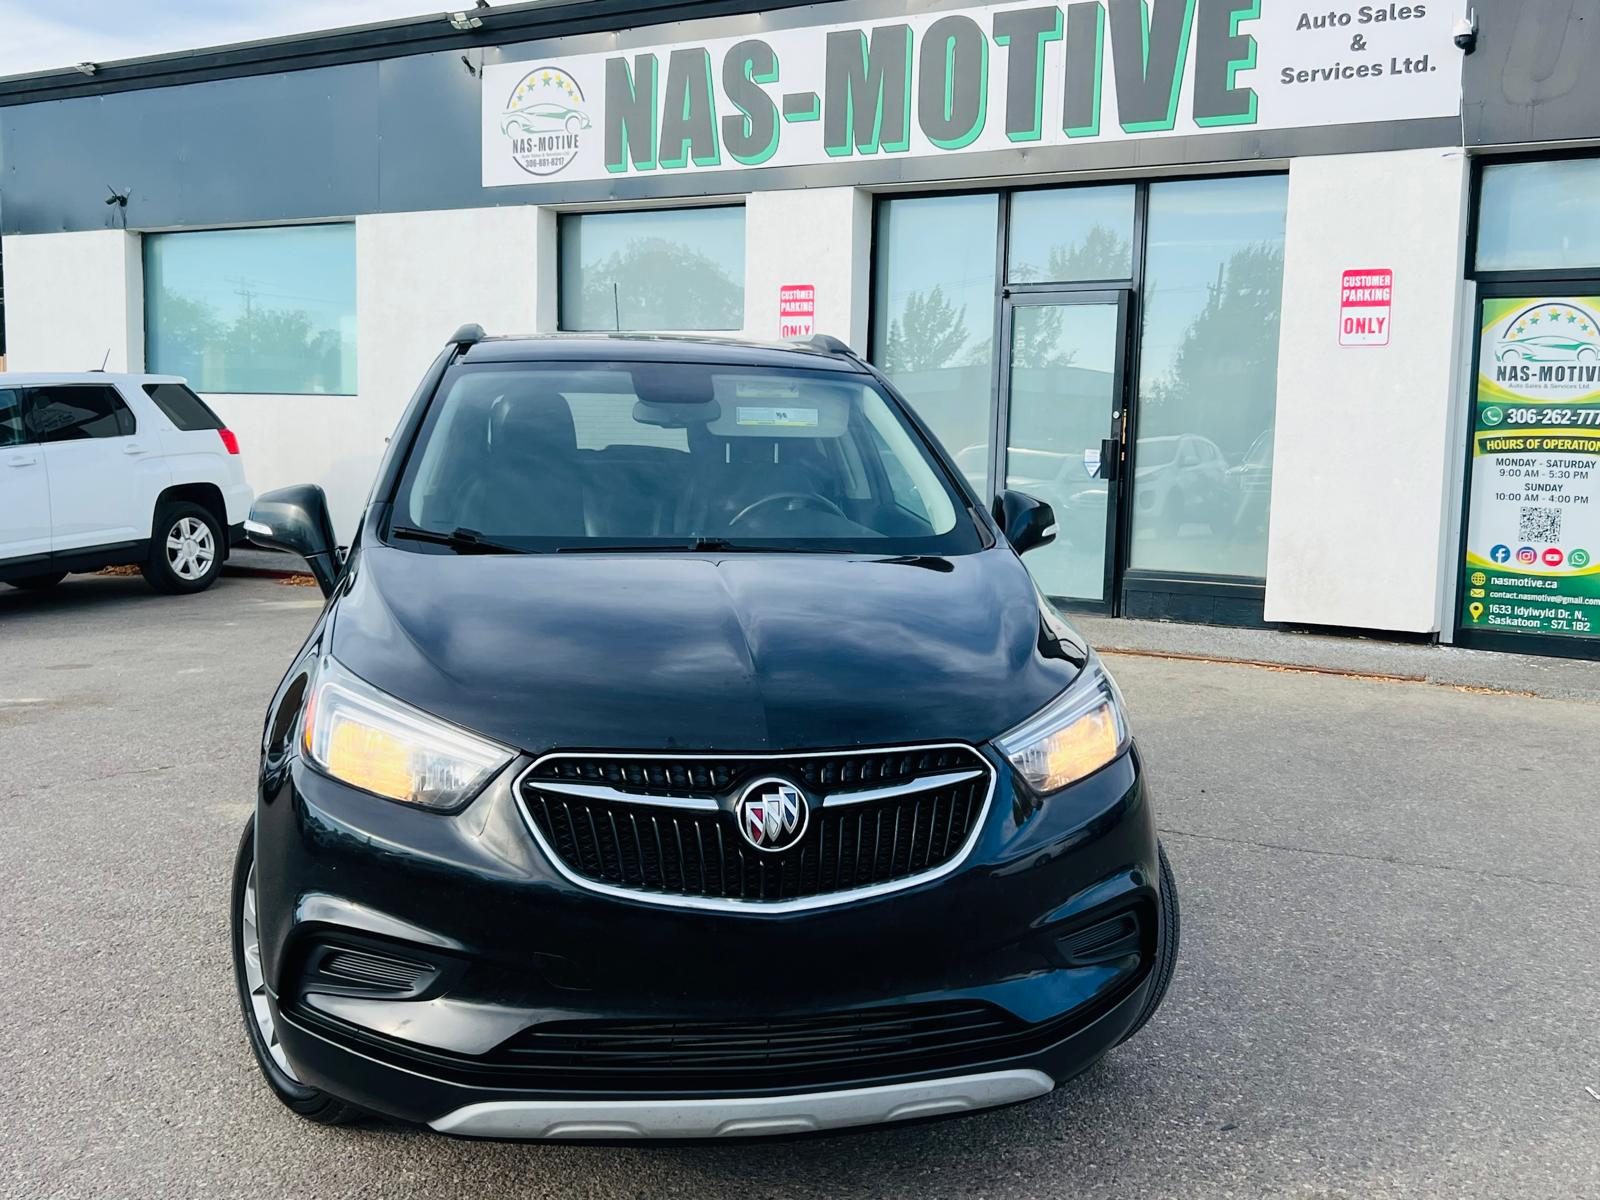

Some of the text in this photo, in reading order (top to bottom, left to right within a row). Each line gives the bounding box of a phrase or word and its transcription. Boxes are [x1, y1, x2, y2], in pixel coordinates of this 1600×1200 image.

[1296, 3, 1426, 31] Auto Sales
[1350, 33, 1367, 51] &
[1280, 55, 1437, 84] Services Ltd.
[605, 0, 1261, 173] NAS-MOTIVE
[512, 134, 579, 154] NAS-MOTIVE
[1343, 275, 1390, 287] CUSTOMER
[1343, 288, 1390, 302] PARKING
[780, 301, 813, 312] PARKING
[1344, 317, 1386, 334] ONLY
[1486, 439, 1524, 451] HOURS
[1526, 439, 1541, 450] OF
[1495, 458, 1537, 467] MONDAY
[1546, 459, 1597, 469] SATURDAY
[1499, 468, 1521, 477] 9:00
[1524, 469, 1539, 478] AM
[1549, 470, 1570, 479] 5:30
[1573, 471, 1589, 480] PM
[1524, 482, 1563, 492] SUNDAY
[1495, 492, 1521, 501] 10:00
[1524, 493, 1539, 502] AM
[1548, 495, 1571, 504] 4:00
[1573, 495, 1589, 504] PM
[1490, 577, 1558, 589] nasmotive.ca
[1488, 604, 1512, 614] 1633
[1514, 606, 1555, 619] Idylwyld
[1557, 609, 1572, 619] Dr.
[1488, 615, 1540, 628] Saskatoon
[1551, 619, 1570, 630] S7L
[1572, 621, 1591, 632] 1B2
